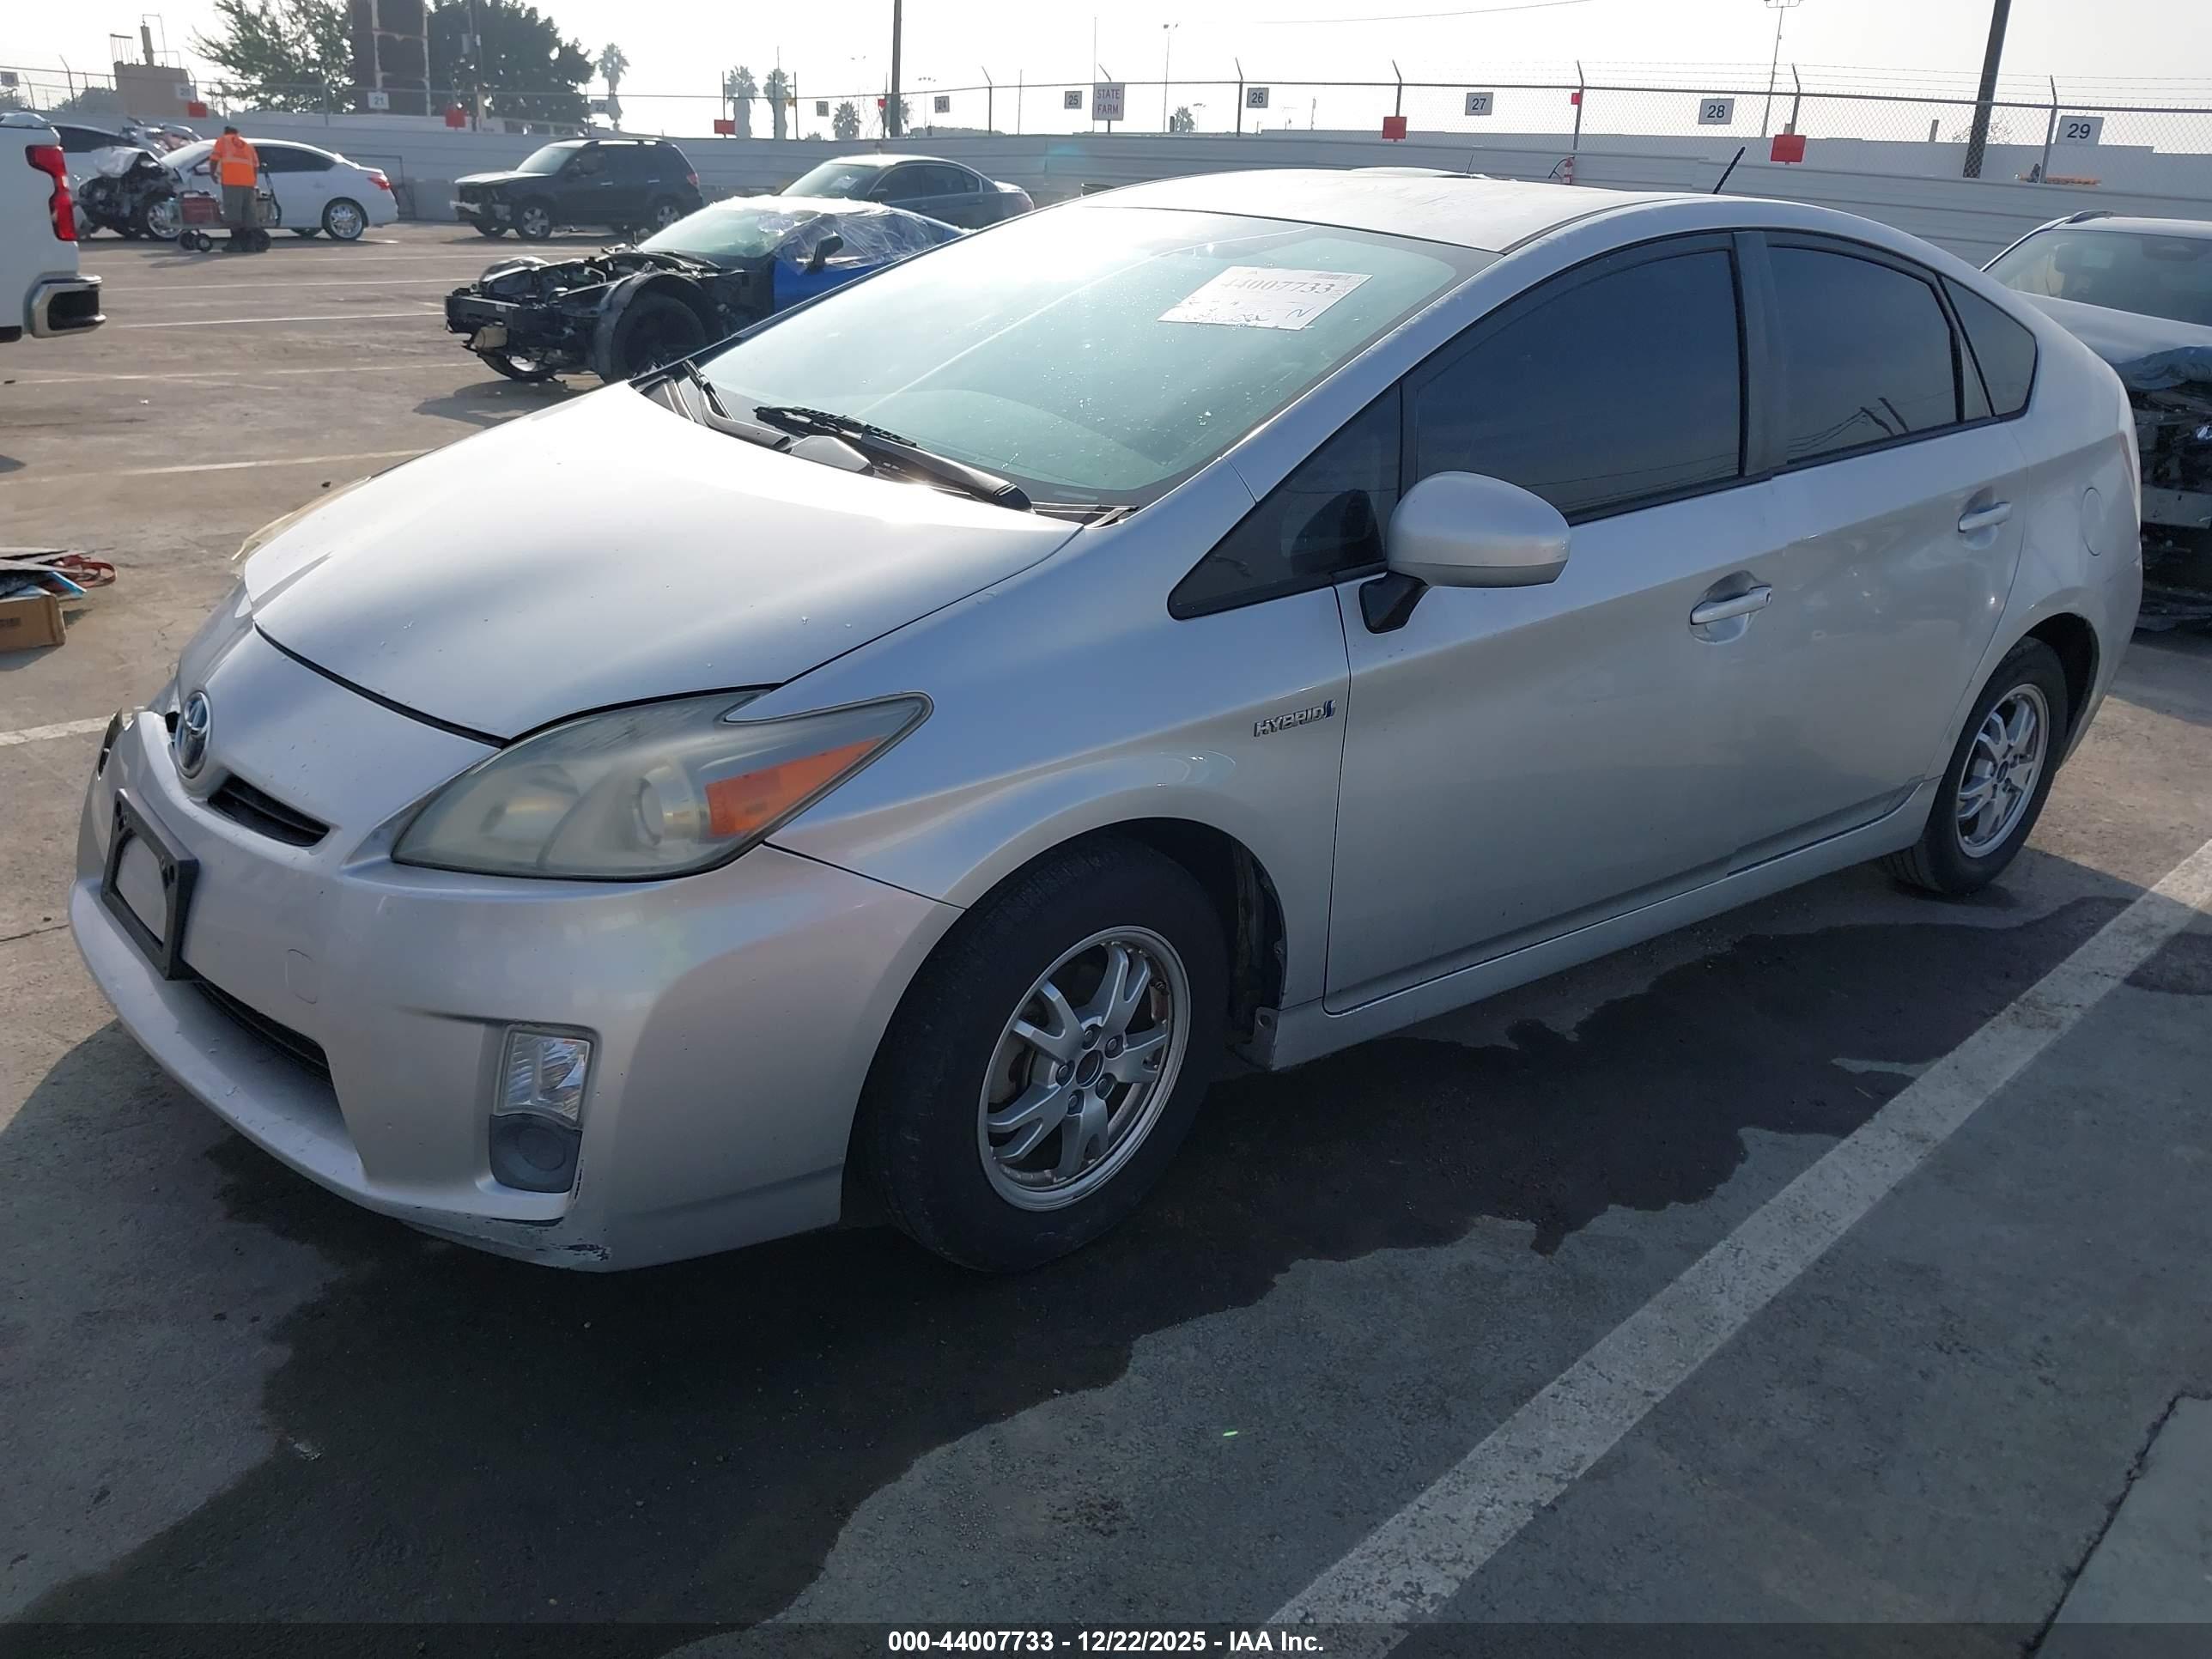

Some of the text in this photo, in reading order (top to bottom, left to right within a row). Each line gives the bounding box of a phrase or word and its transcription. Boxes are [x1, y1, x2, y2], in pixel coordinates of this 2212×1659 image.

[1097, 88, 1121, 100] STATE
[1252, 92, 1264, 104] 26
[374, 96, 385, 106] 21
[595, 102, 606, 111] 22
[937, 99, 947, 108] 24
[1068, 95, 1079, 106] 25
[1472, 98, 1486, 110] 27
[1097, 104, 1119, 115] FARM
[1707, 105, 1725, 118] 28
[2067, 124, 2091, 138] 29
[1254, 706, 1326, 737] HYBRID
